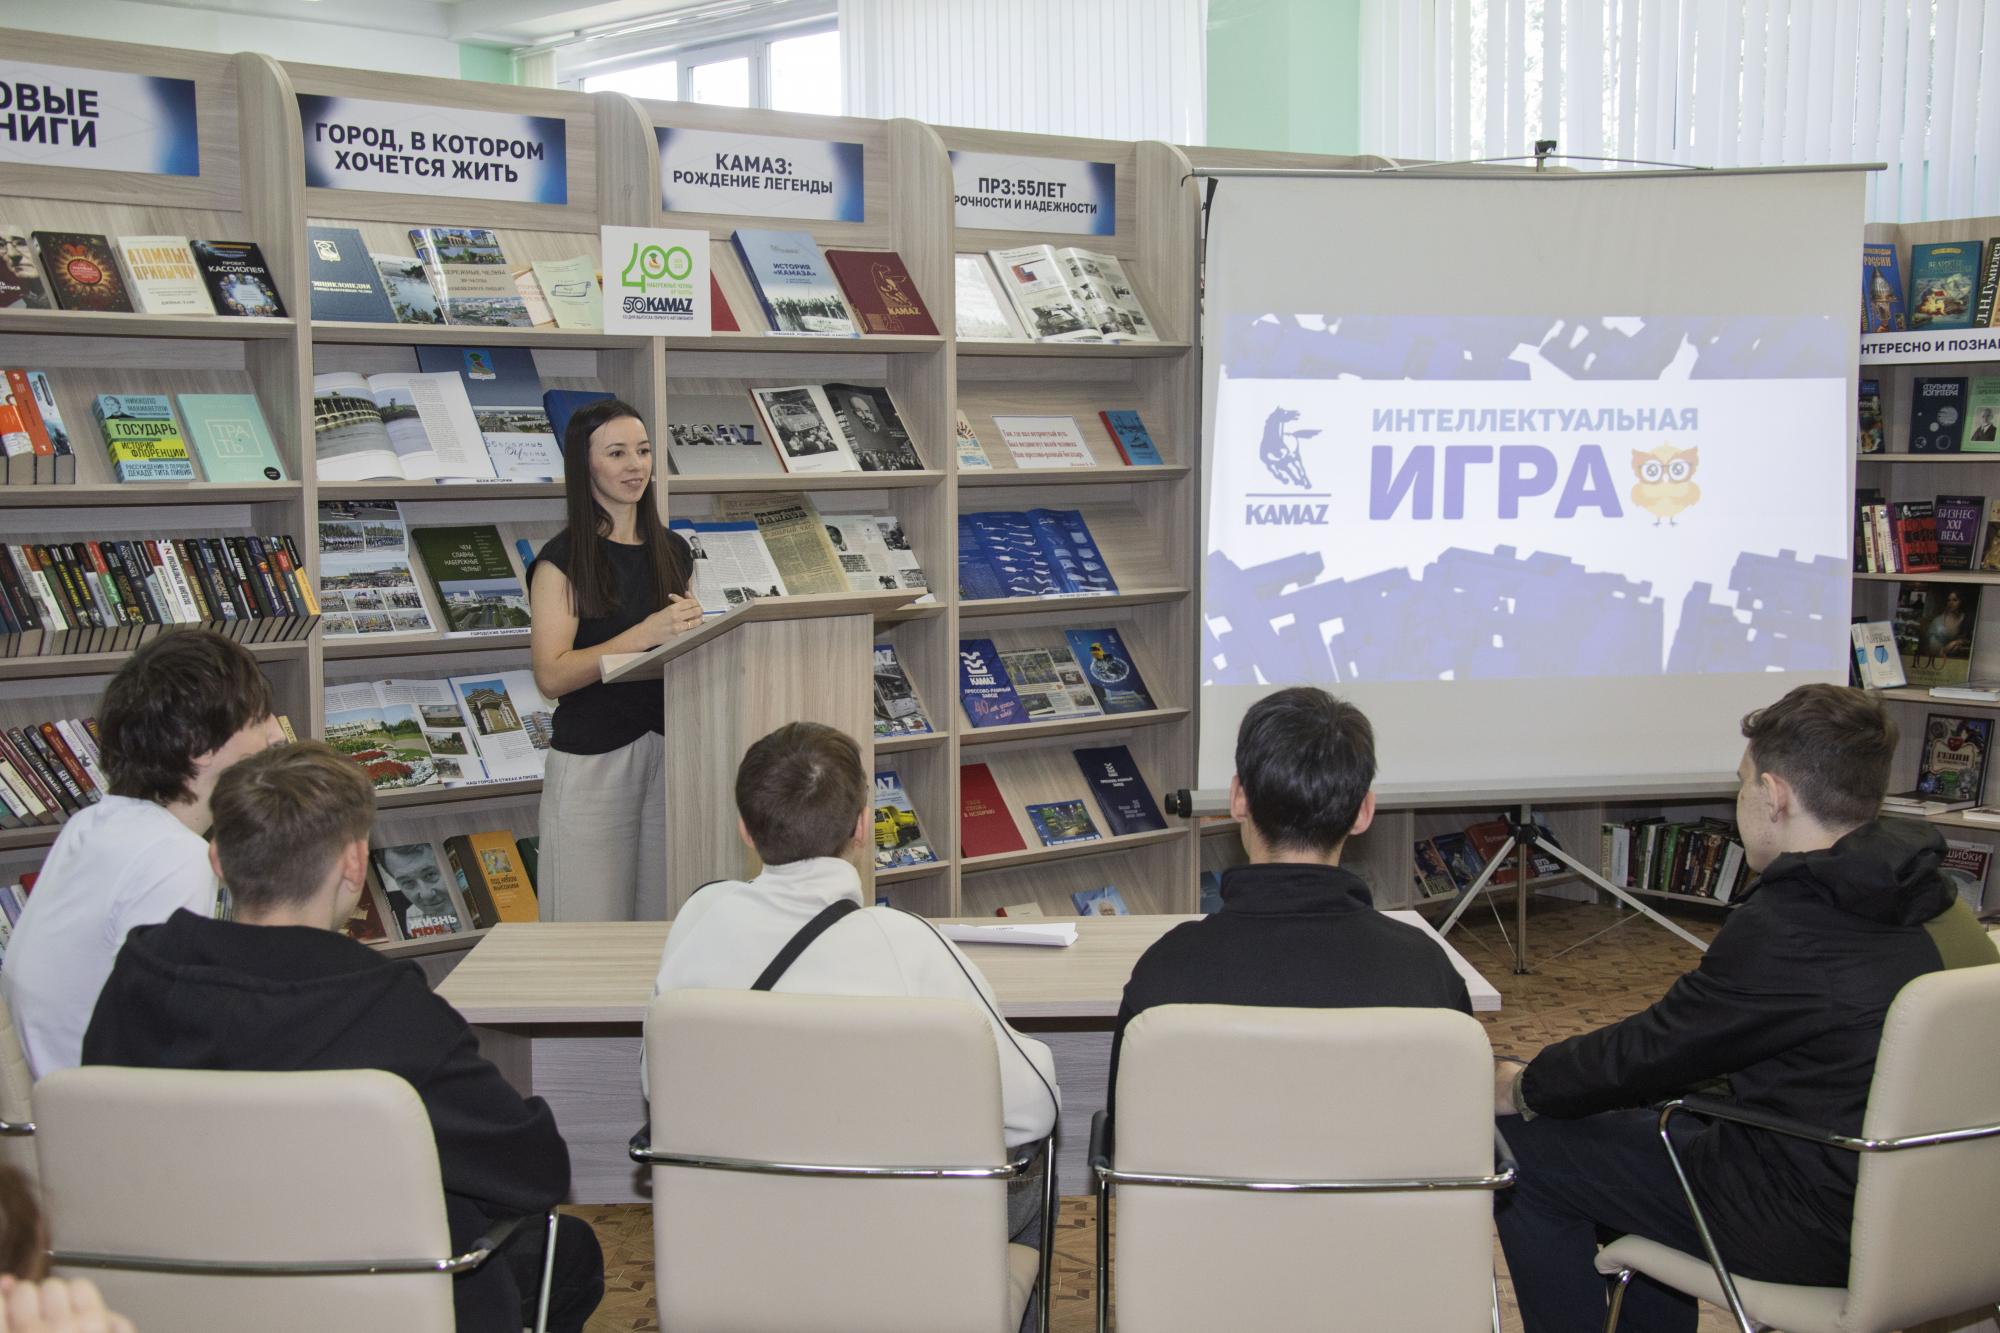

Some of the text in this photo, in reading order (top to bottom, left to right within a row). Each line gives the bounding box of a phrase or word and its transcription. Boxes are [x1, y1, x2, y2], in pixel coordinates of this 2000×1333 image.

[0, 113, 97, 148] НИГИ
[314, 122, 545, 161] ГОРОД, В КОТОРОМ
[334, 150, 519, 183] ХОЧЕТСЯ ЖИТЬ
[714, 152, 793, 176] КАМАЗ:
[672, 170, 834, 195] РОЖДЕНИЕ ЛЕГЕНДЫ
[954, 195, 1098, 216] РОЧНОСТИ И НАДЕЖНОСТИ
[127, 248, 192, 264] АТОМНЫЕ
[646, 297, 693, 312] KAMAZ
[1861, 338, 2000, 355] НТЕРЕСНО И ПОЗНА
[1371, 407, 1699, 432] ИНТЕЛЛЕКТУАЛЬНАЯ
[115, 423, 177, 436] ГОСУДАРЬ
[121, 442, 155, 450] ИСТОРИЯ
[131, 449, 186, 458] ФЛОРЕНЦИИ
[1369, 444, 1624, 521] ИГРА
[1245, 504, 1329, 526] KAMAZ
[1938, 509, 1975, 519] БИЗНЕС
[1946, 520, 1962, 530] XXI
[1941, 531, 1964, 541] ВЕКА
[970, 677, 996, 685] KAMAZ
[1946, 849, 1983, 862] ШИБКИ
[410, 915, 457, 927] ЖИЗНЬ
